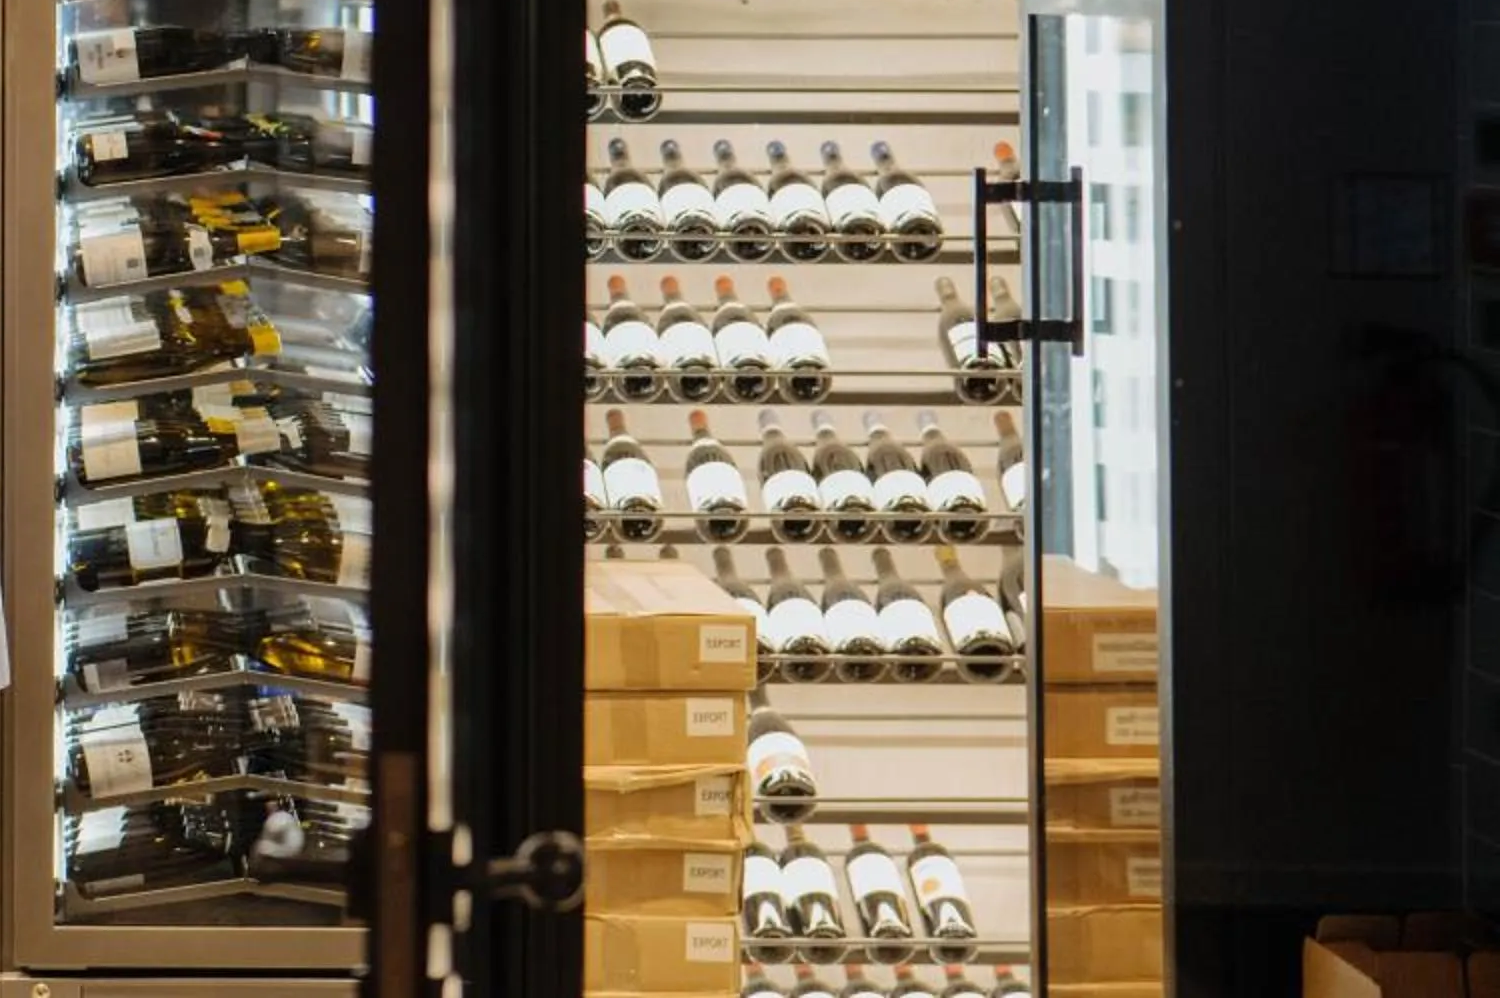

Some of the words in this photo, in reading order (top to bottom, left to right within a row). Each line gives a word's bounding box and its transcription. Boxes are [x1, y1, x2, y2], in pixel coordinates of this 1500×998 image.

[705, 637, 741, 650] EXPORT
[692, 710, 729, 724] EXPORT
[689, 866, 725, 879] EXPORT
[692, 936, 729, 949] EXPORT
